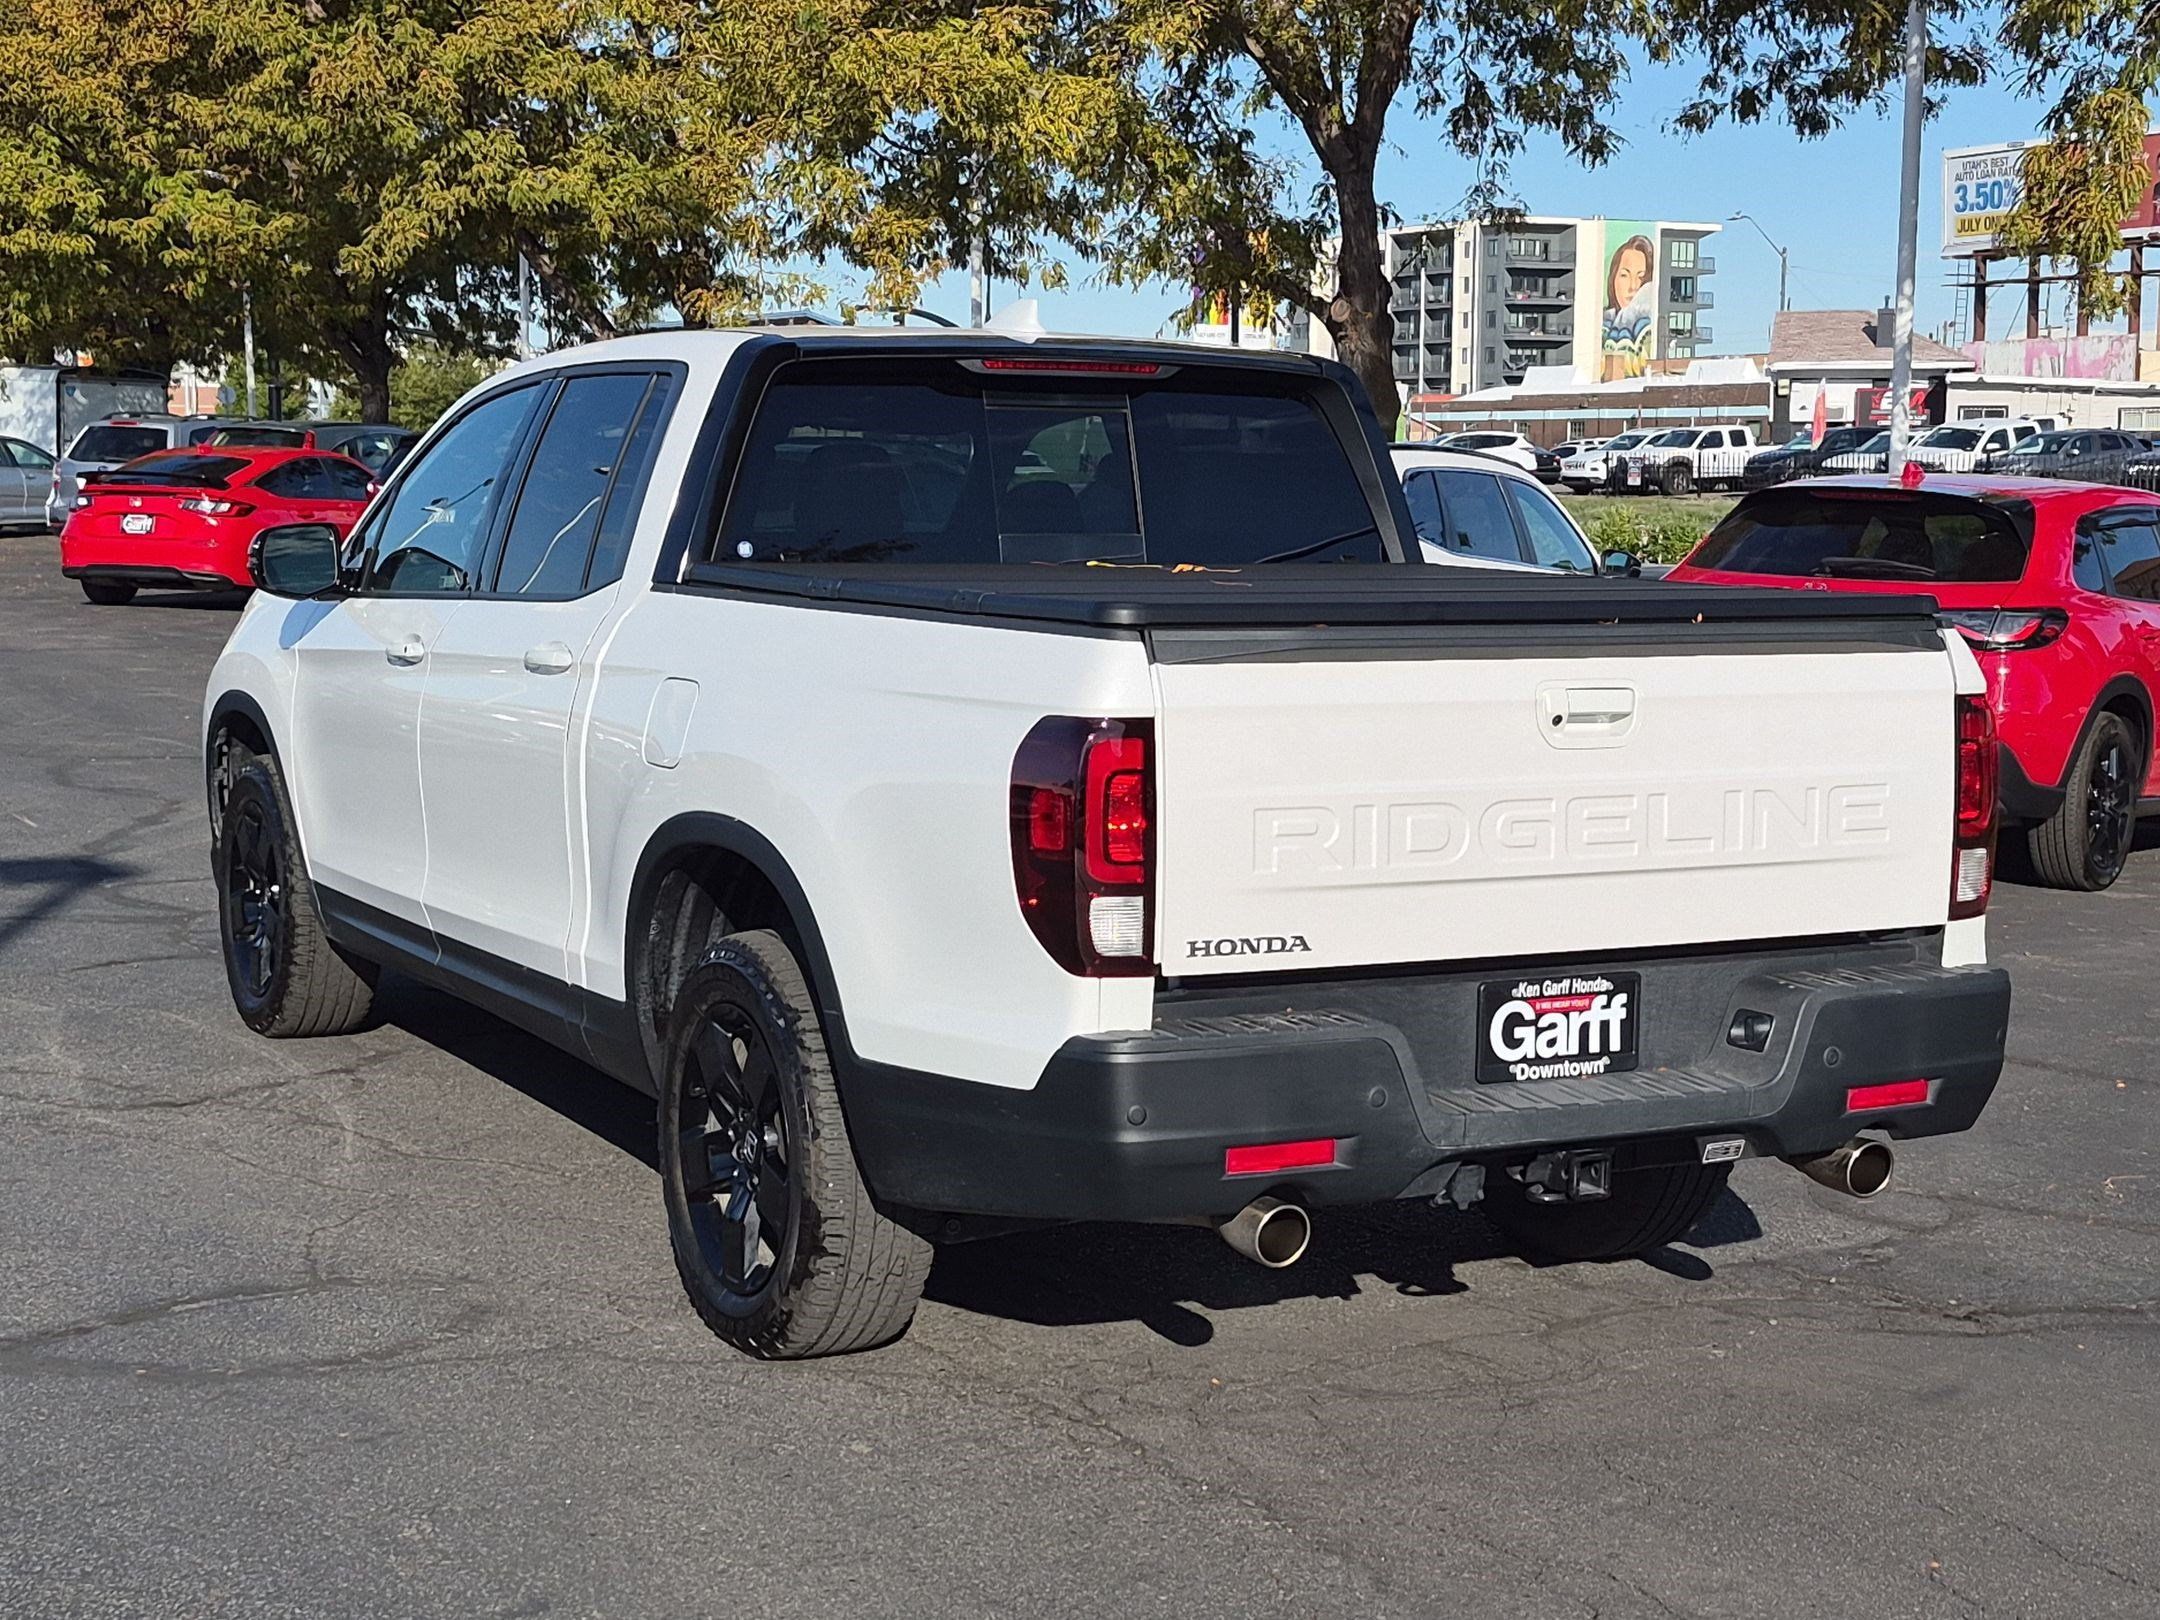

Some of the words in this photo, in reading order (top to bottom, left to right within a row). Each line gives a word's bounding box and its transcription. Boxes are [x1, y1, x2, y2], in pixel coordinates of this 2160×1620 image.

[1962, 159, 1988, 170] UTAH'S
[1990, 157, 2009, 168] BEST
[1954, 170, 1974, 182] AUTO
[1975, 168, 1996, 180] LOAN
[1957, 217, 1981, 233] JULY
[1252, 783, 1891, 876] RIDGELINE
[1186, 935, 1312, 958] HONDA
[1518, 981, 1540, 998] Ken
[1542, 979, 1569, 996] Garff
[1571, 976, 1607, 993] Honda
[1489, 992, 1628, 1062] Garff
[1515, 1058, 1605, 1081] Downtown
